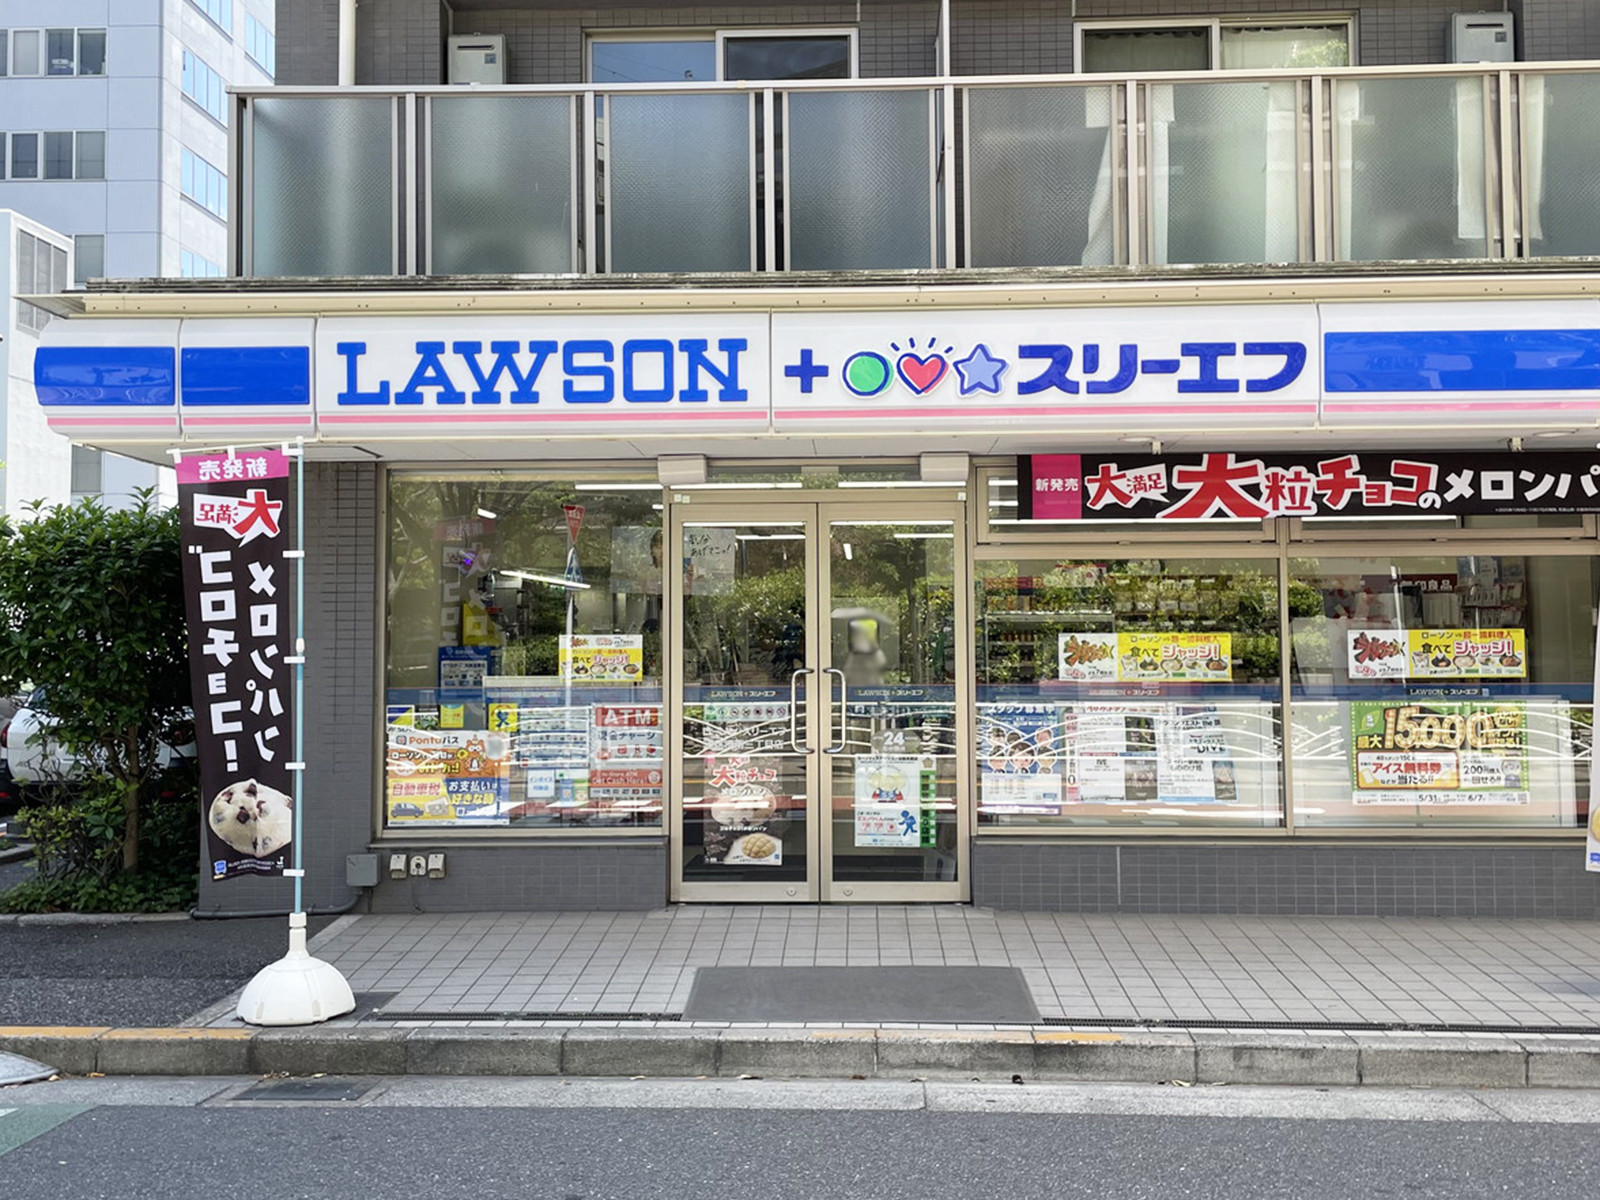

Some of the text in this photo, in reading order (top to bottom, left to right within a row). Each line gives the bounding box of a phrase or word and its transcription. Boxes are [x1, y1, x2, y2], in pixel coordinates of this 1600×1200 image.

[337, 338, 748, 405] LAWSON
[1017, 341, 1307, 396] スリーエフ
[1035, 478, 1079, 492] 新発売
[1086, 464, 1166, 507] 大満足
[604, 709, 651, 724] ATM
[883, 731, 906, 746] 24
